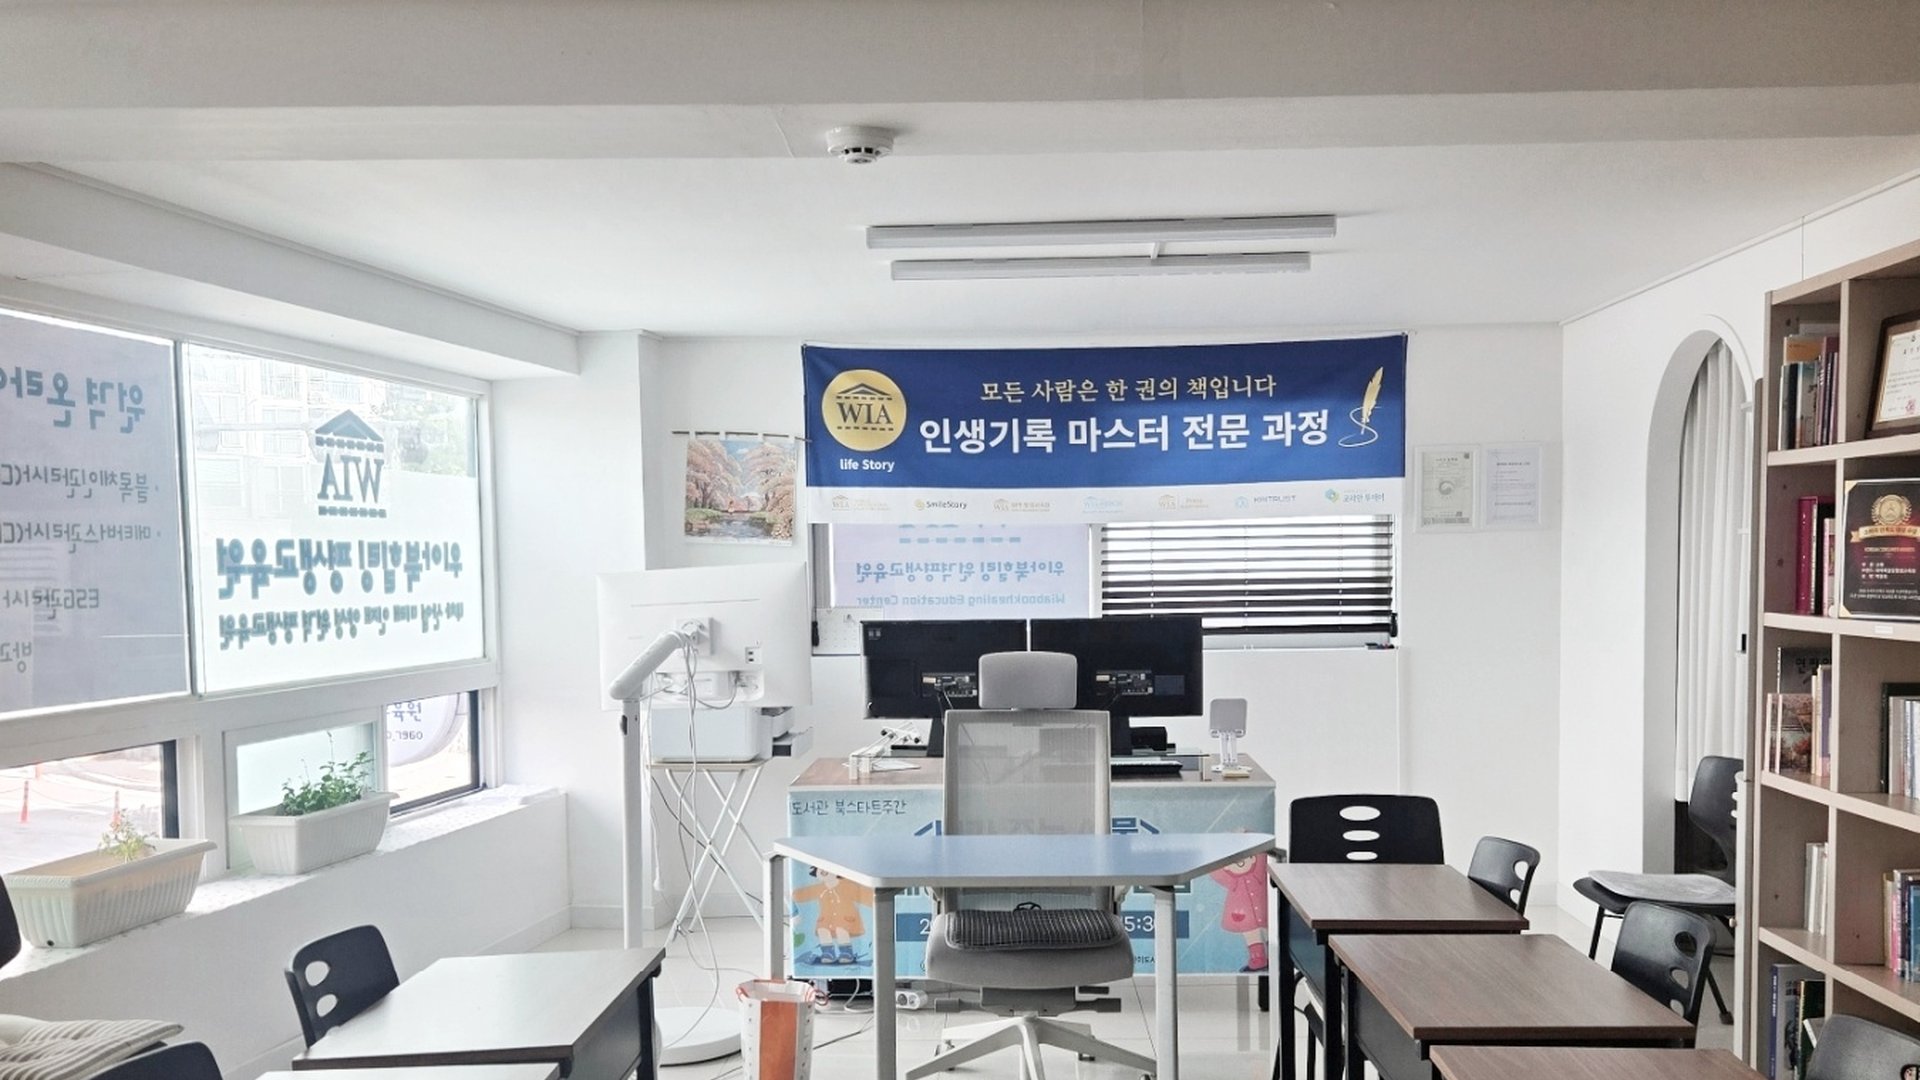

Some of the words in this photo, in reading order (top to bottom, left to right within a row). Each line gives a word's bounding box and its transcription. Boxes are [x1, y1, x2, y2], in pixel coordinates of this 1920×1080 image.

[980, 381, 1026, 404] 모든
[1031, 378, 1098, 403] 사람은
[1105, 378, 1128, 402] 한
[1135, 376, 1178, 401] 권의
[1187, 373, 1277, 400] 책입니다
[837, 402, 894, 425] WIA
[919, 416, 1057, 454] 인생기록
[1068, 413, 1169, 453] 마스터
[1182, 412, 1251, 451] 전문
[1262, 408, 1330, 448] 과정
[839, 457, 859, 471] life
[862, 458, 895, 473] Story
[791, 799, 829, 816] 도서관
[835, 799, 907, 816] 북스타트주간
